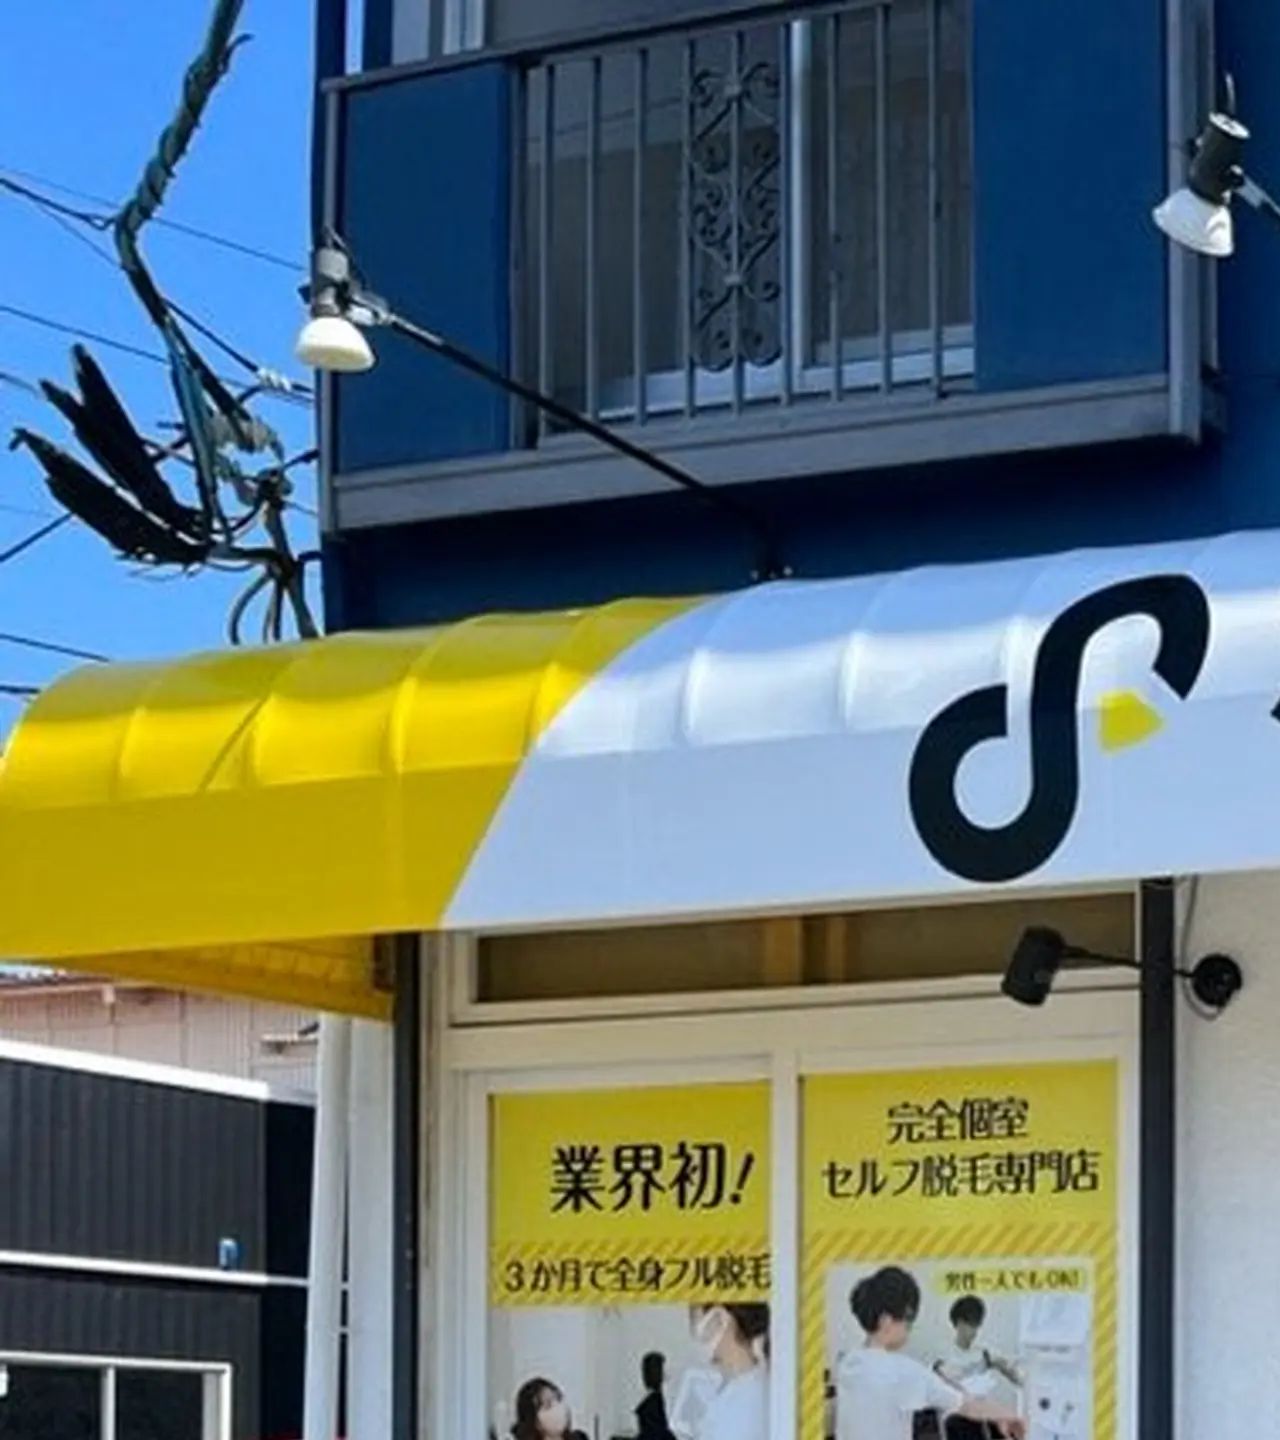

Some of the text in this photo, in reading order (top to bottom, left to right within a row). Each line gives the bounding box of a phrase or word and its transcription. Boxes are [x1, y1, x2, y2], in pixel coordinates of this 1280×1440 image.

[887, 1096, 1030, 1145] 完全個室
[550, 1140, 755, 1213] 業界初!
[822, 1149, 1100, 1199] セルフ脱毛専門店
[505, 1250, 771, 1293] 3か月で全身フル脱毛
